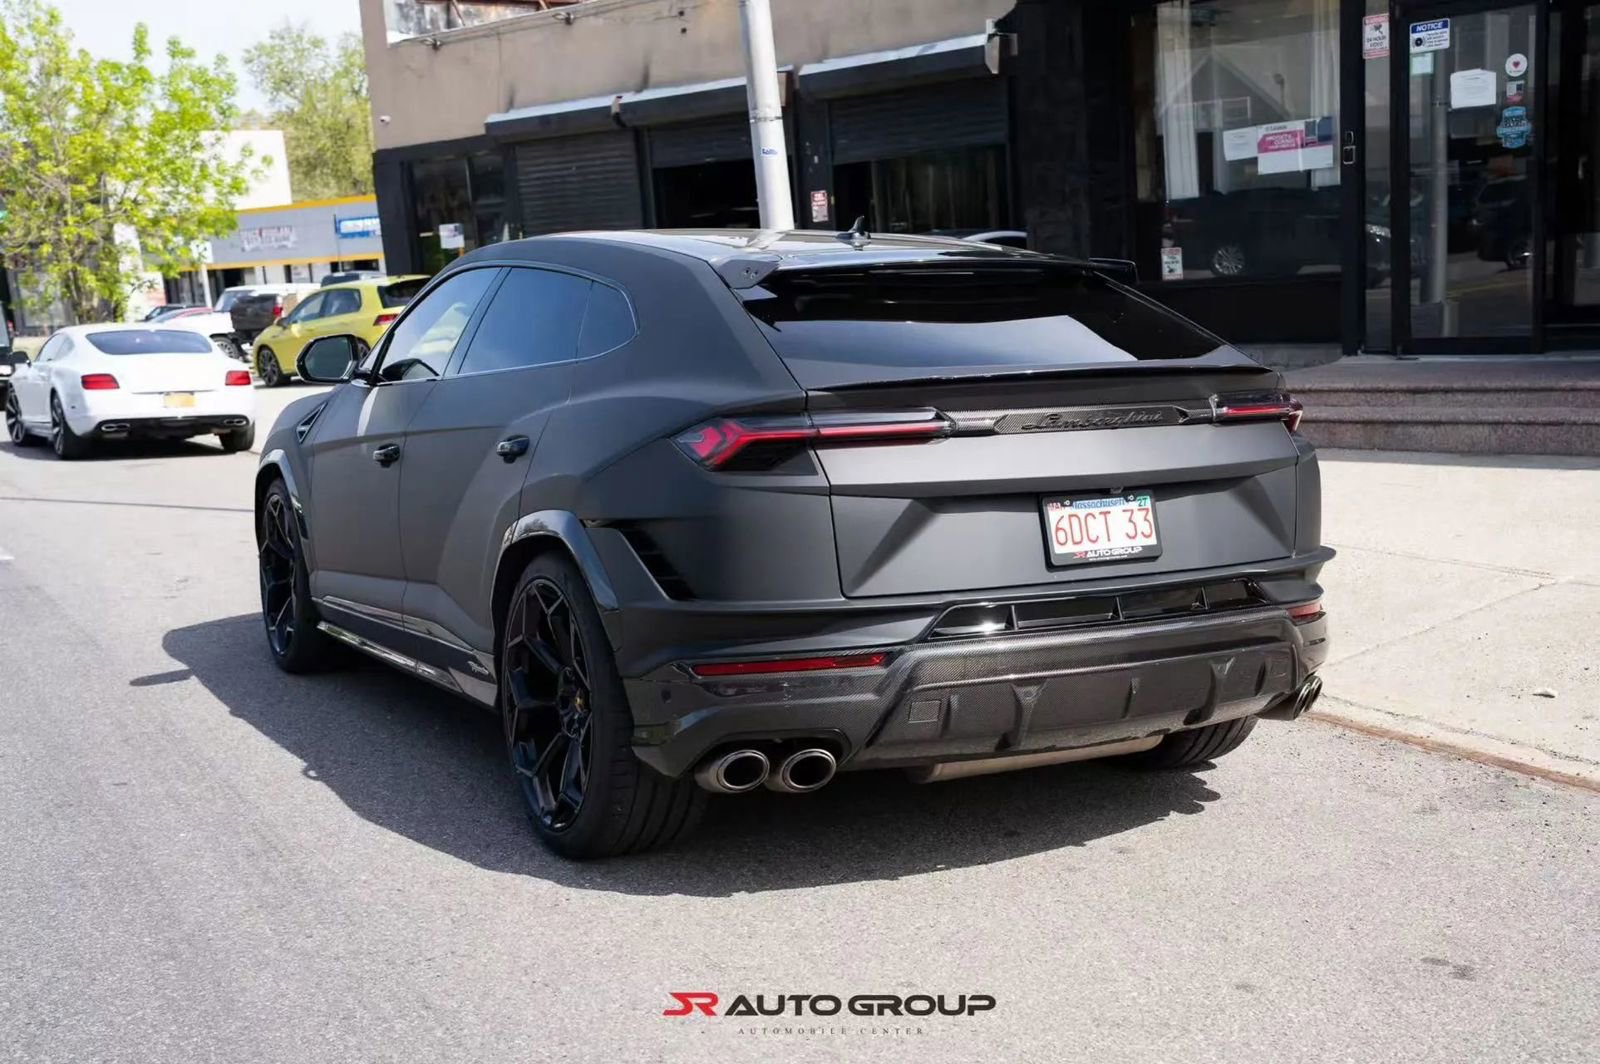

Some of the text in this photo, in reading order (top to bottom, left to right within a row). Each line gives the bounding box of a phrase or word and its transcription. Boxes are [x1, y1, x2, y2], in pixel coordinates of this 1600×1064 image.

[1416, 21, 1443, 32] NOTICE
[1021, 409, 1163, 431] Lamborghini
[1137, 497, 1149, 507] 27
[1055, 507, 1153, 547] 6DCT 33
[1087, 548, 1111, 558] AUTO
[1111, 546, 1143, 556] GROUP
